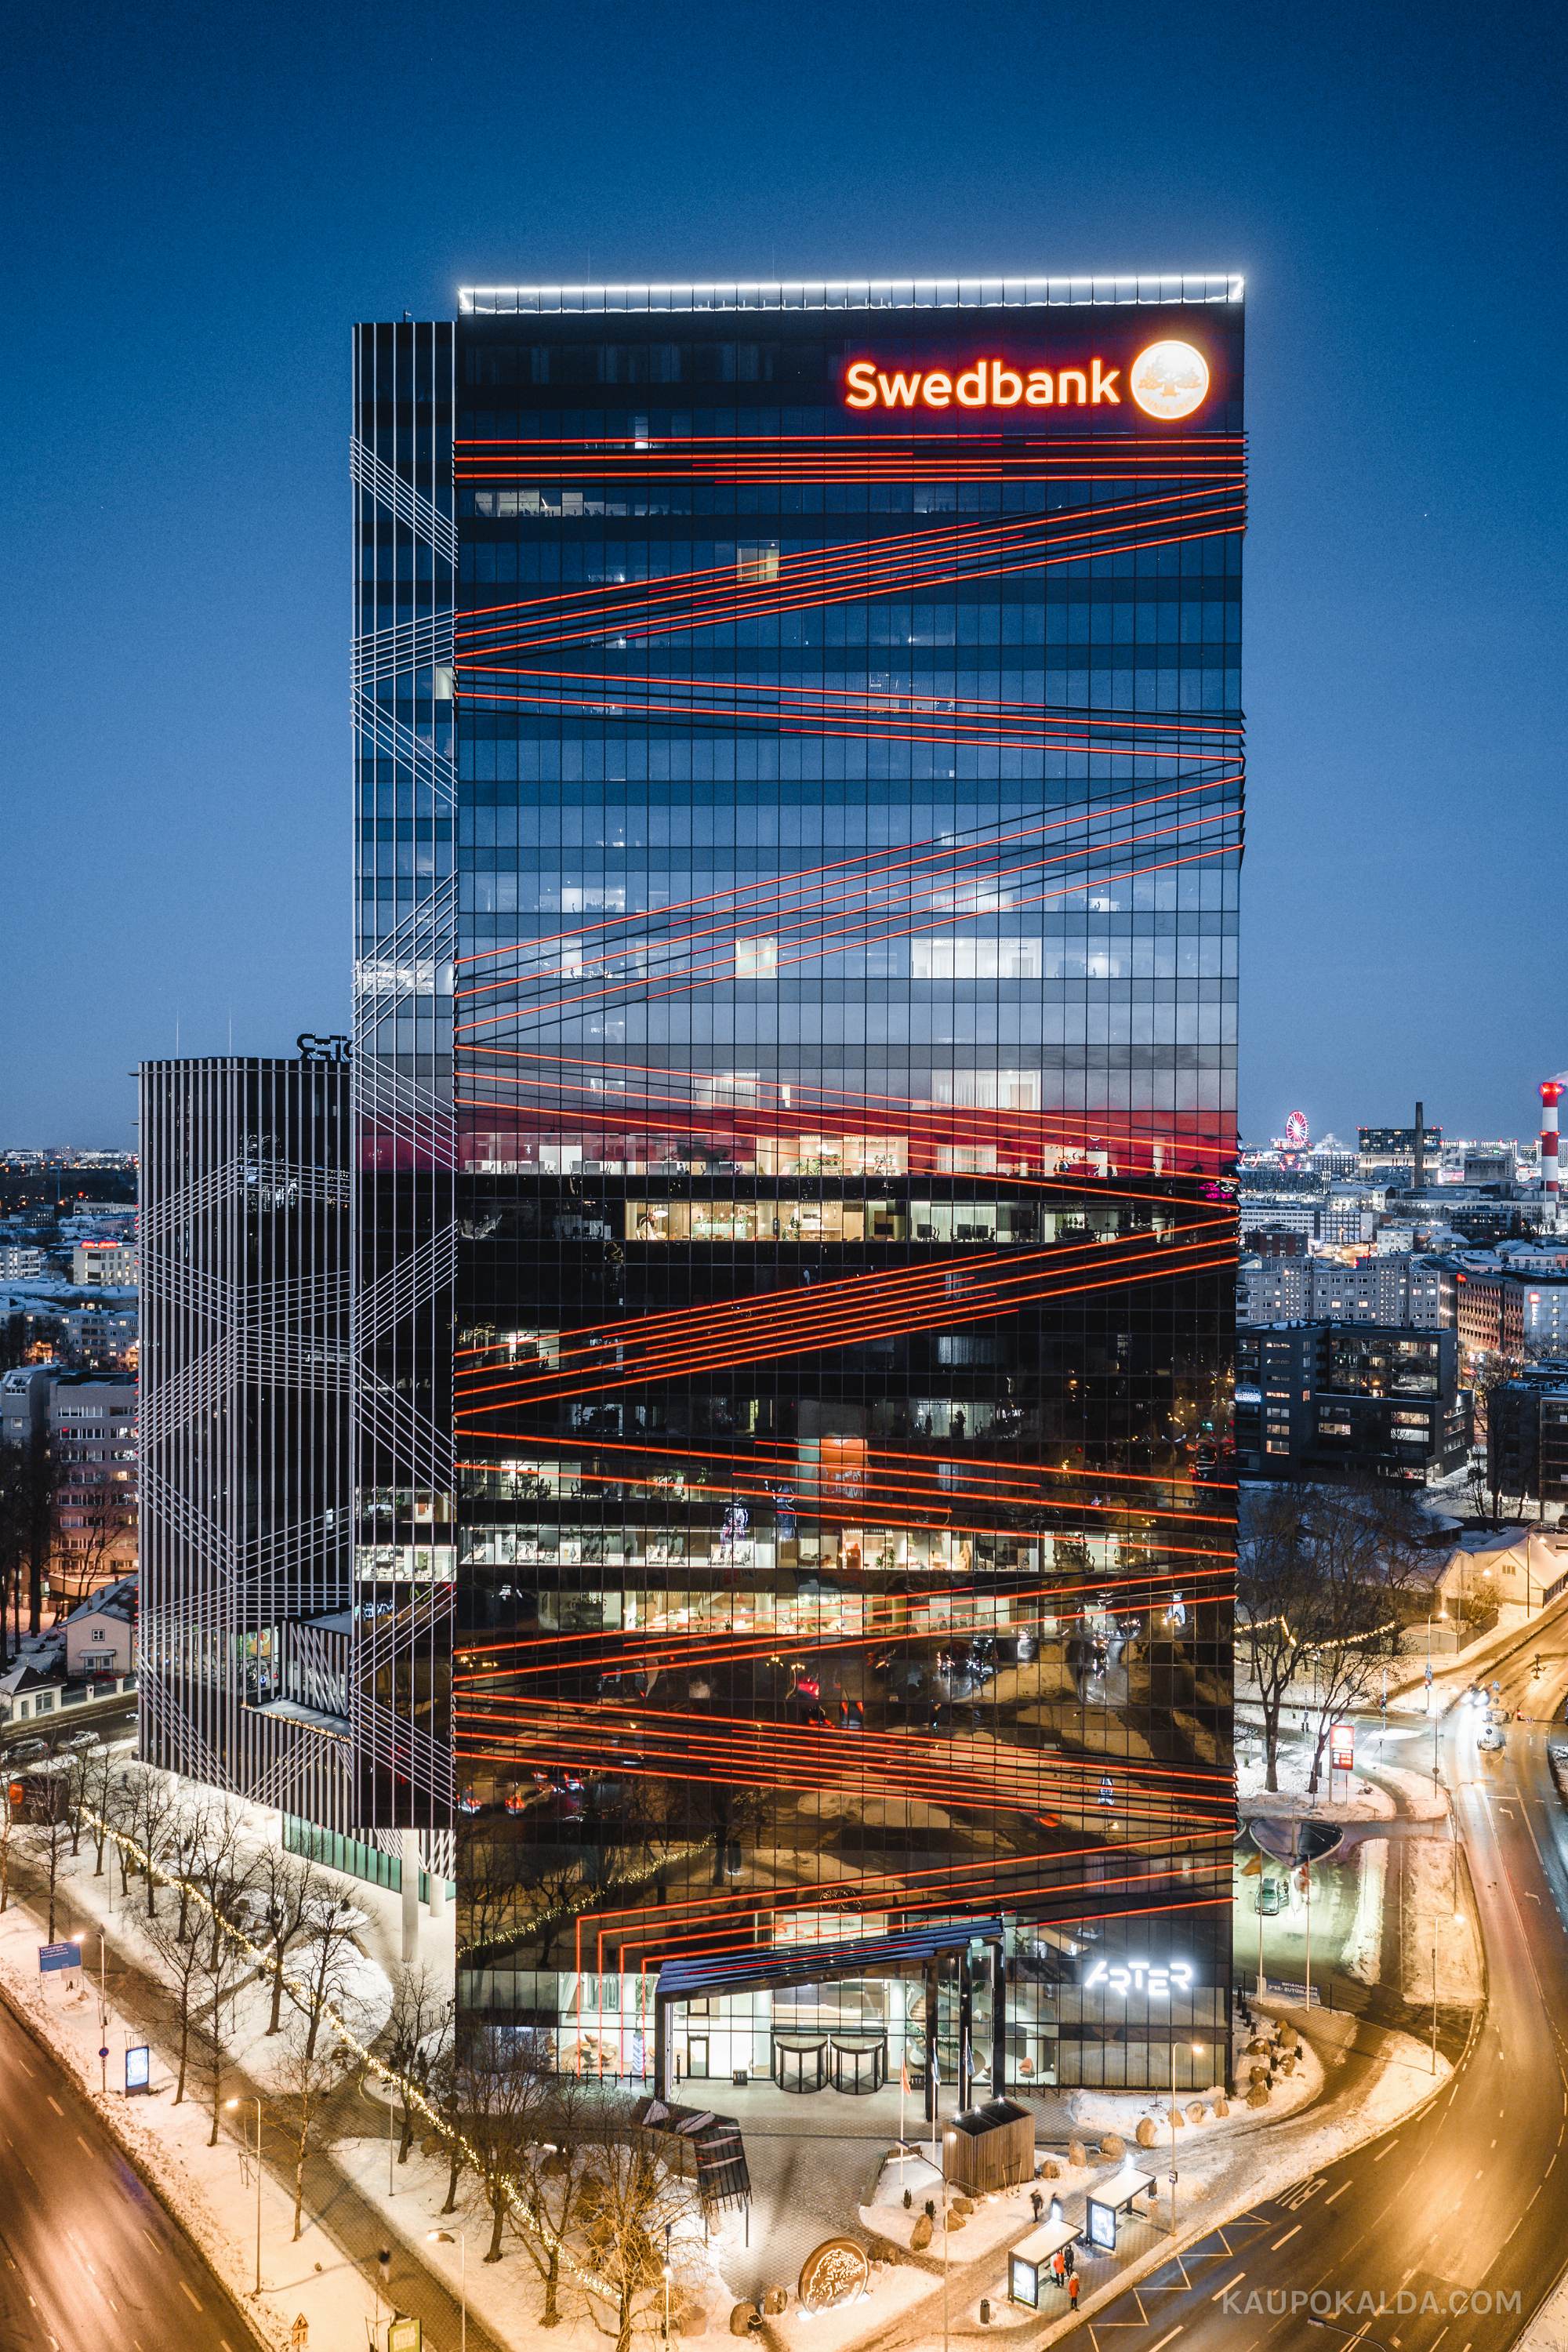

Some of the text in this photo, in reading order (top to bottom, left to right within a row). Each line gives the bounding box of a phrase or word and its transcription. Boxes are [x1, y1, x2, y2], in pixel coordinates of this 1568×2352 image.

[846, 358, 1121, 407] Swedbank
[1084, 1961, 1192, 1996] ARTER
[1269, 2175, 1328, 2211] BU
